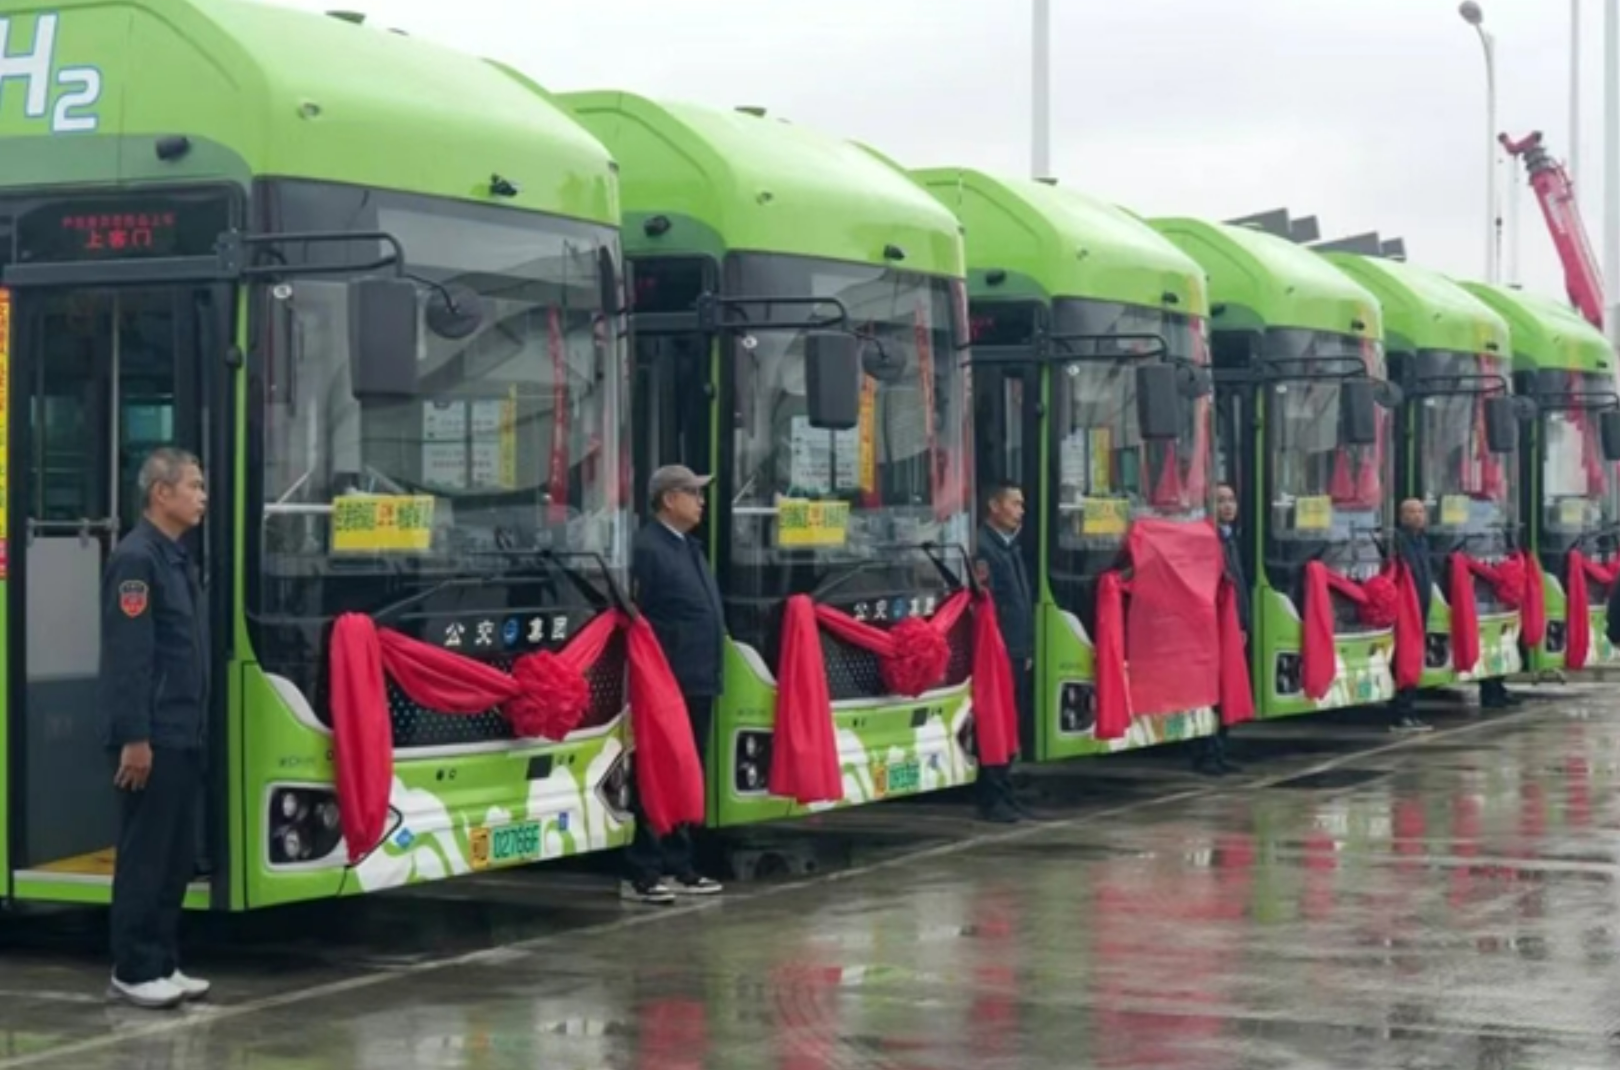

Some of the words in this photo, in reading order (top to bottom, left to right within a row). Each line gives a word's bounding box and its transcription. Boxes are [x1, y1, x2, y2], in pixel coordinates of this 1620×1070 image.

[84, 228, 152, 250] 上客门
[443, 619, 495, 647] 公交
